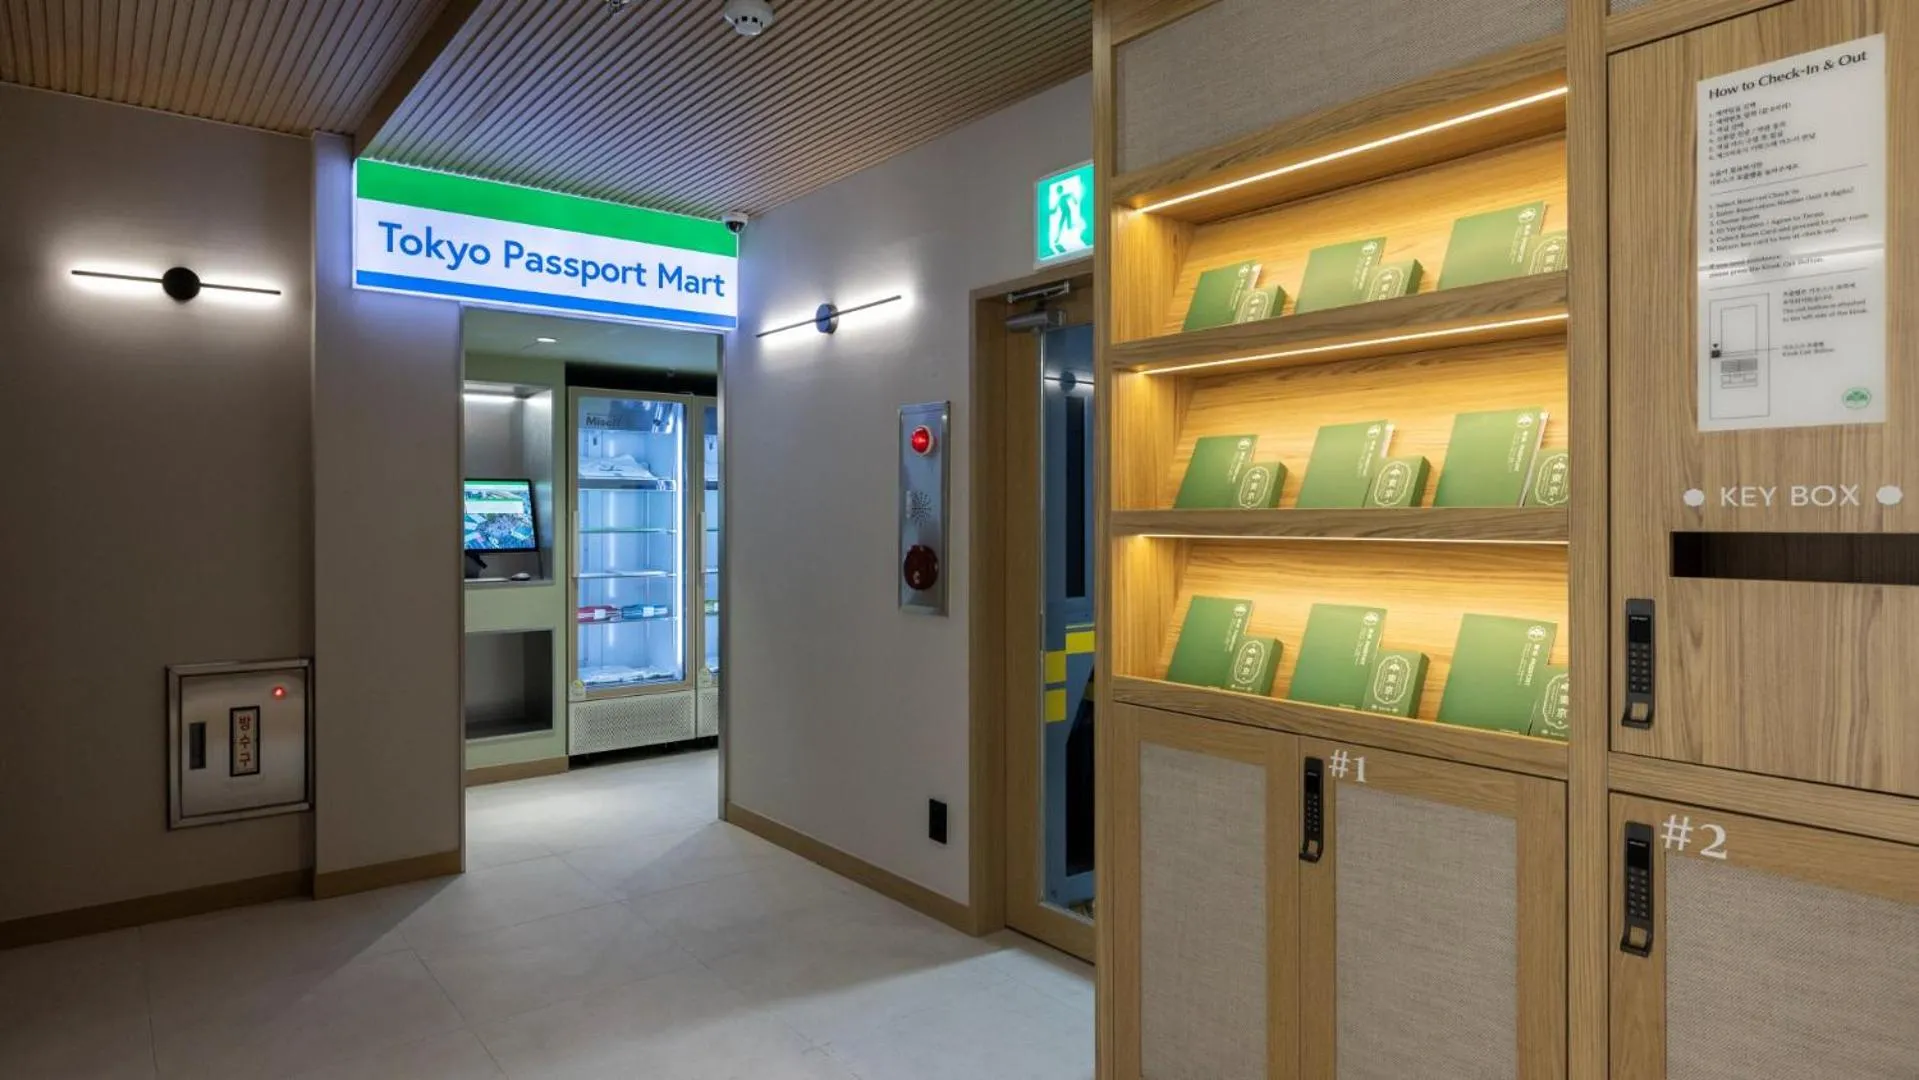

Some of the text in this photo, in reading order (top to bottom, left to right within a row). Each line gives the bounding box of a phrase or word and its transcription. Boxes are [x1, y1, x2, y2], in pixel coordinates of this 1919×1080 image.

[1708, 50, 1867, 100] How to Check-In & Out
[378, 221, 726, 297] Tokyo Passport Mart
[1720, 484, 1859, 507] KEY BOX
[238, 715, 251, 767] 방수구
[1329, 749, 1367, 783] #1
[1660, 813, 1728, 859] #2
